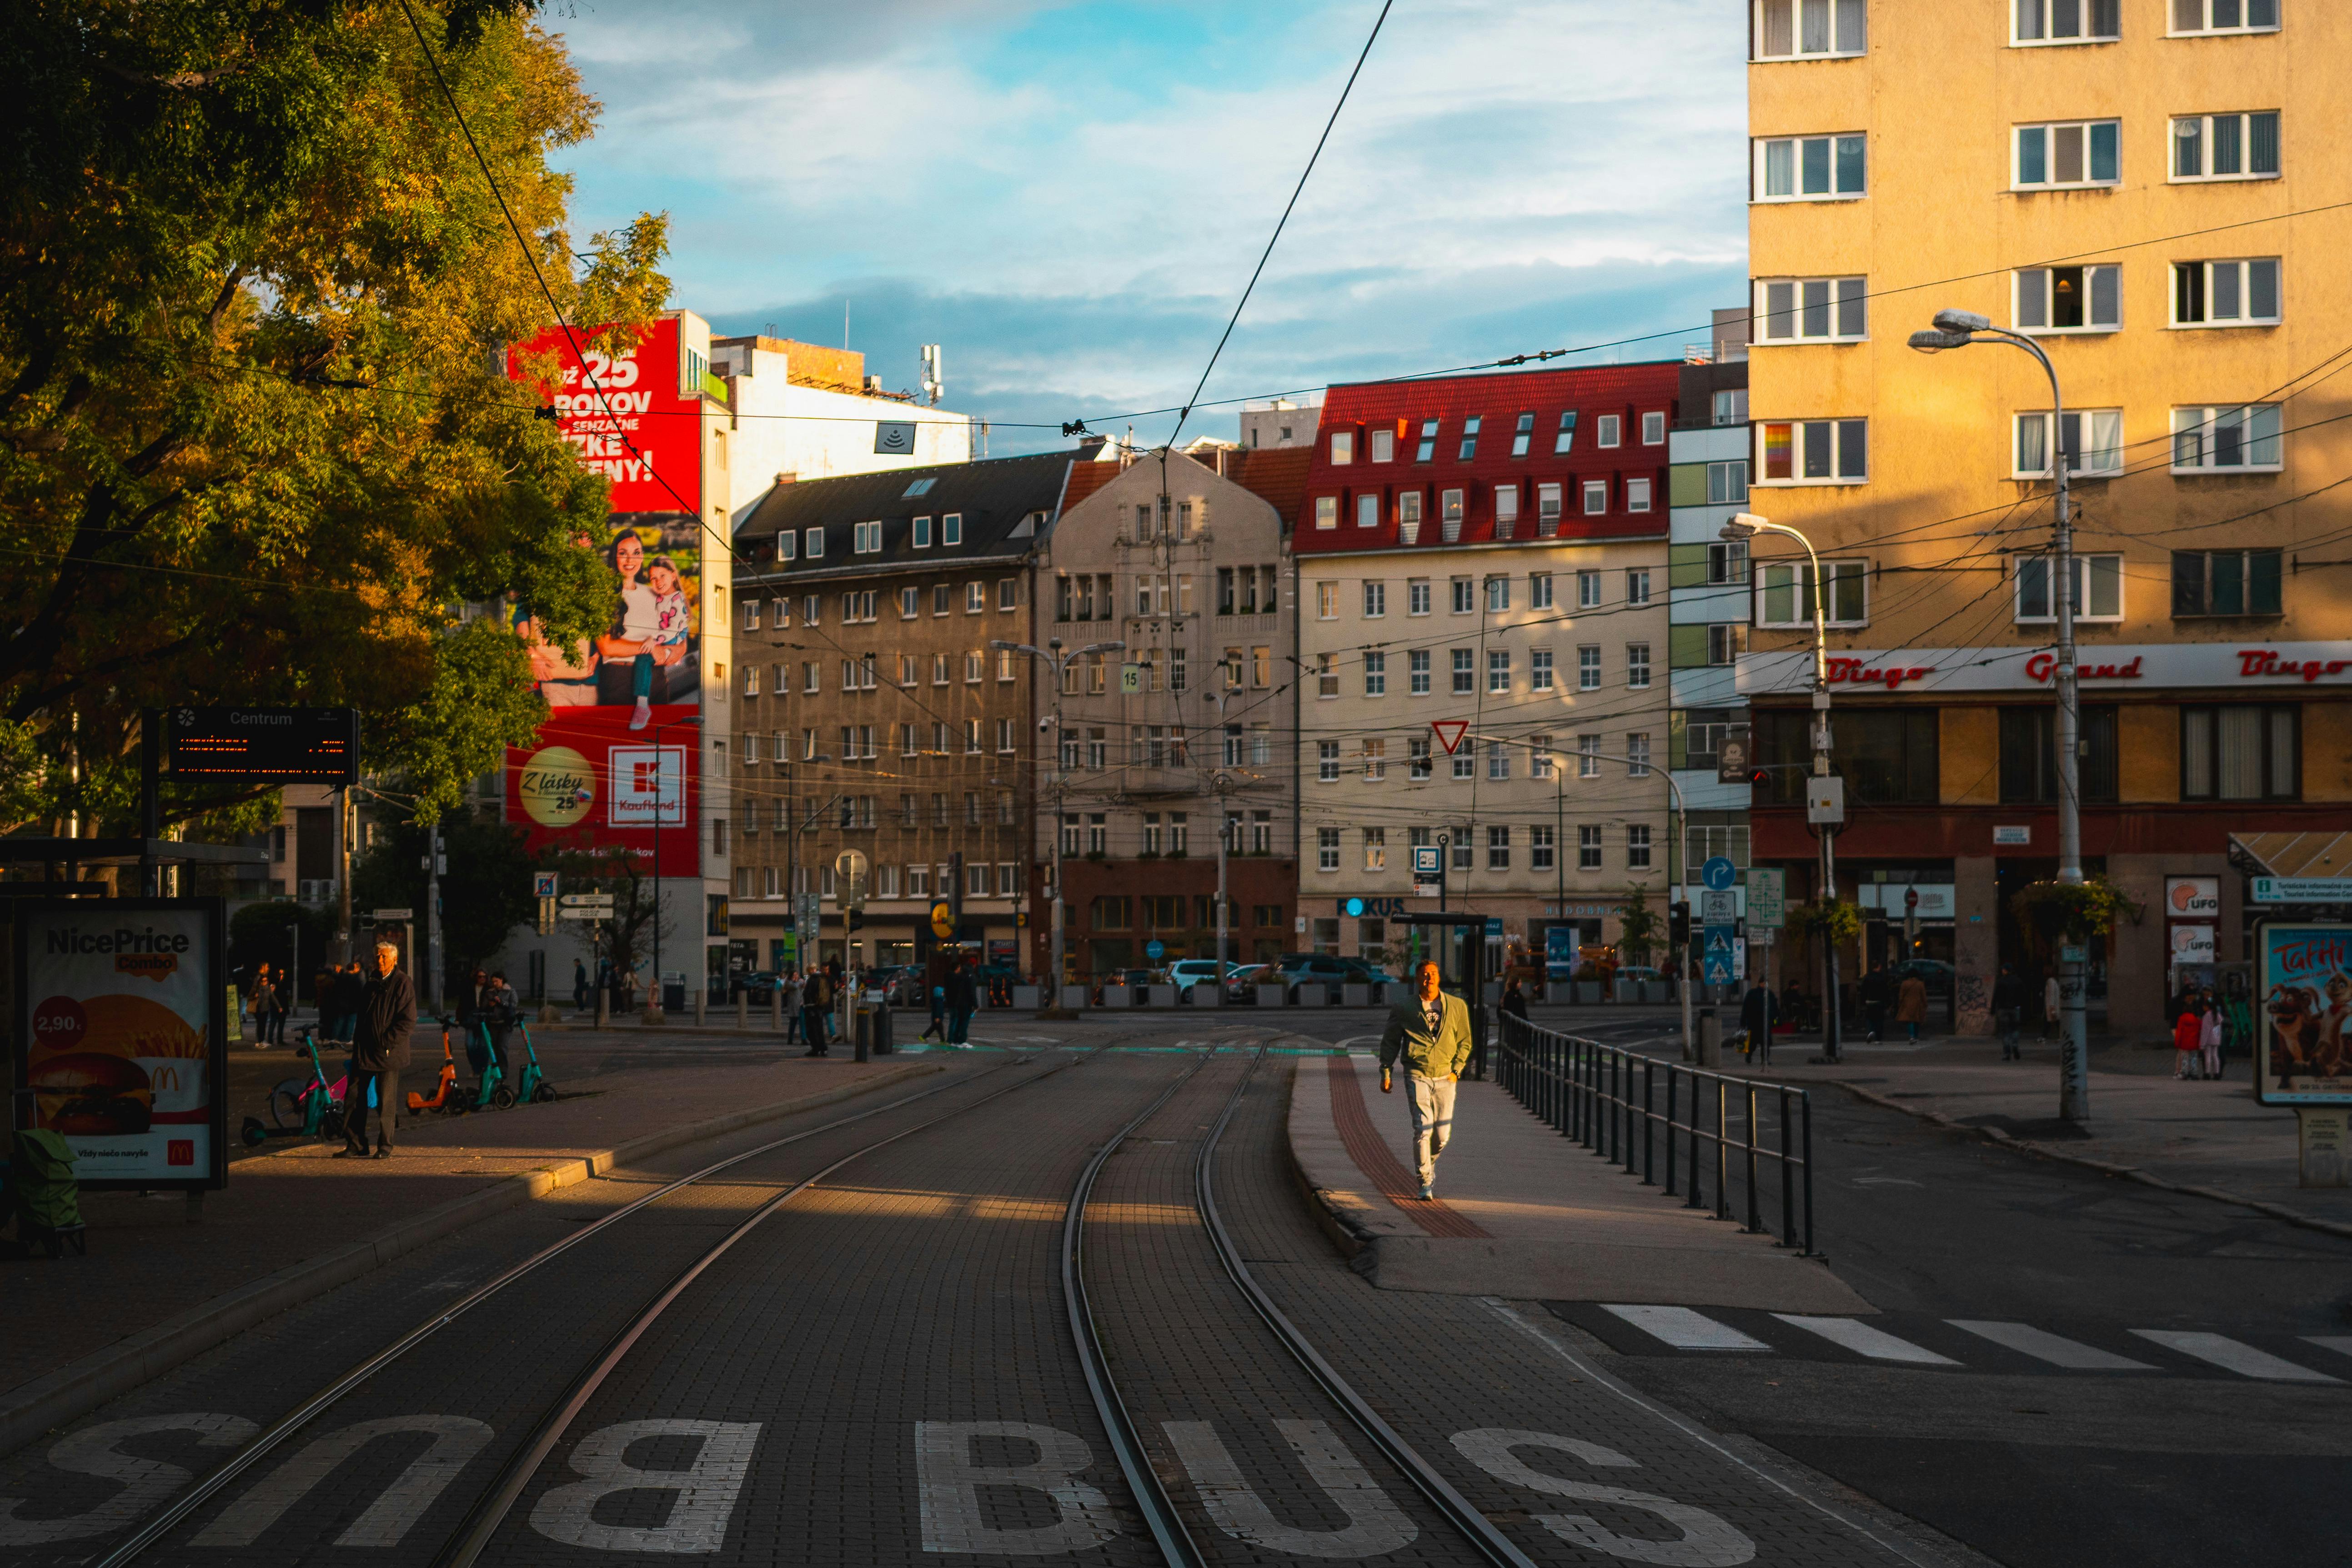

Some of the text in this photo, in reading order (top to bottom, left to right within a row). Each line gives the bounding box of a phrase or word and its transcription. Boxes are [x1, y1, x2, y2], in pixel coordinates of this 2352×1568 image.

[581, 350, 639, 389] 25
[553, 391, 652, 417] ROKOV
[572, 417, 640, 433] SENZAČNE
[1825, 657, 1936, 689] Bingo
[2025, 653, 2142, 682] Gand
[2237, 649, 2352, 681] Bingo
[1124, 672, 1136, 686] 15
[230, 712, 292, 725] Centrum
[539, 773, 583, 794] lásky
[556, 796, 574, 809] 25
[619, 799, 675, 811] Kaufland
[1337, 897, 1404, 917] FOKUS
[2191, 899, 2217, 909] UFO
[47, 927, 189, 954] NicePrice
[2191, 941, 2212, 950] UFO
[118, 957, 172, 970] Combo
[2273, 937, 2347, 973] Tafiti
[37, 1016, 75, 1032] 2,90
[78, 1150, 97, 1159] Vždy
[121, 1149, 148, 1158] navyše
[915, 1418, 1755, 1567] BUS
